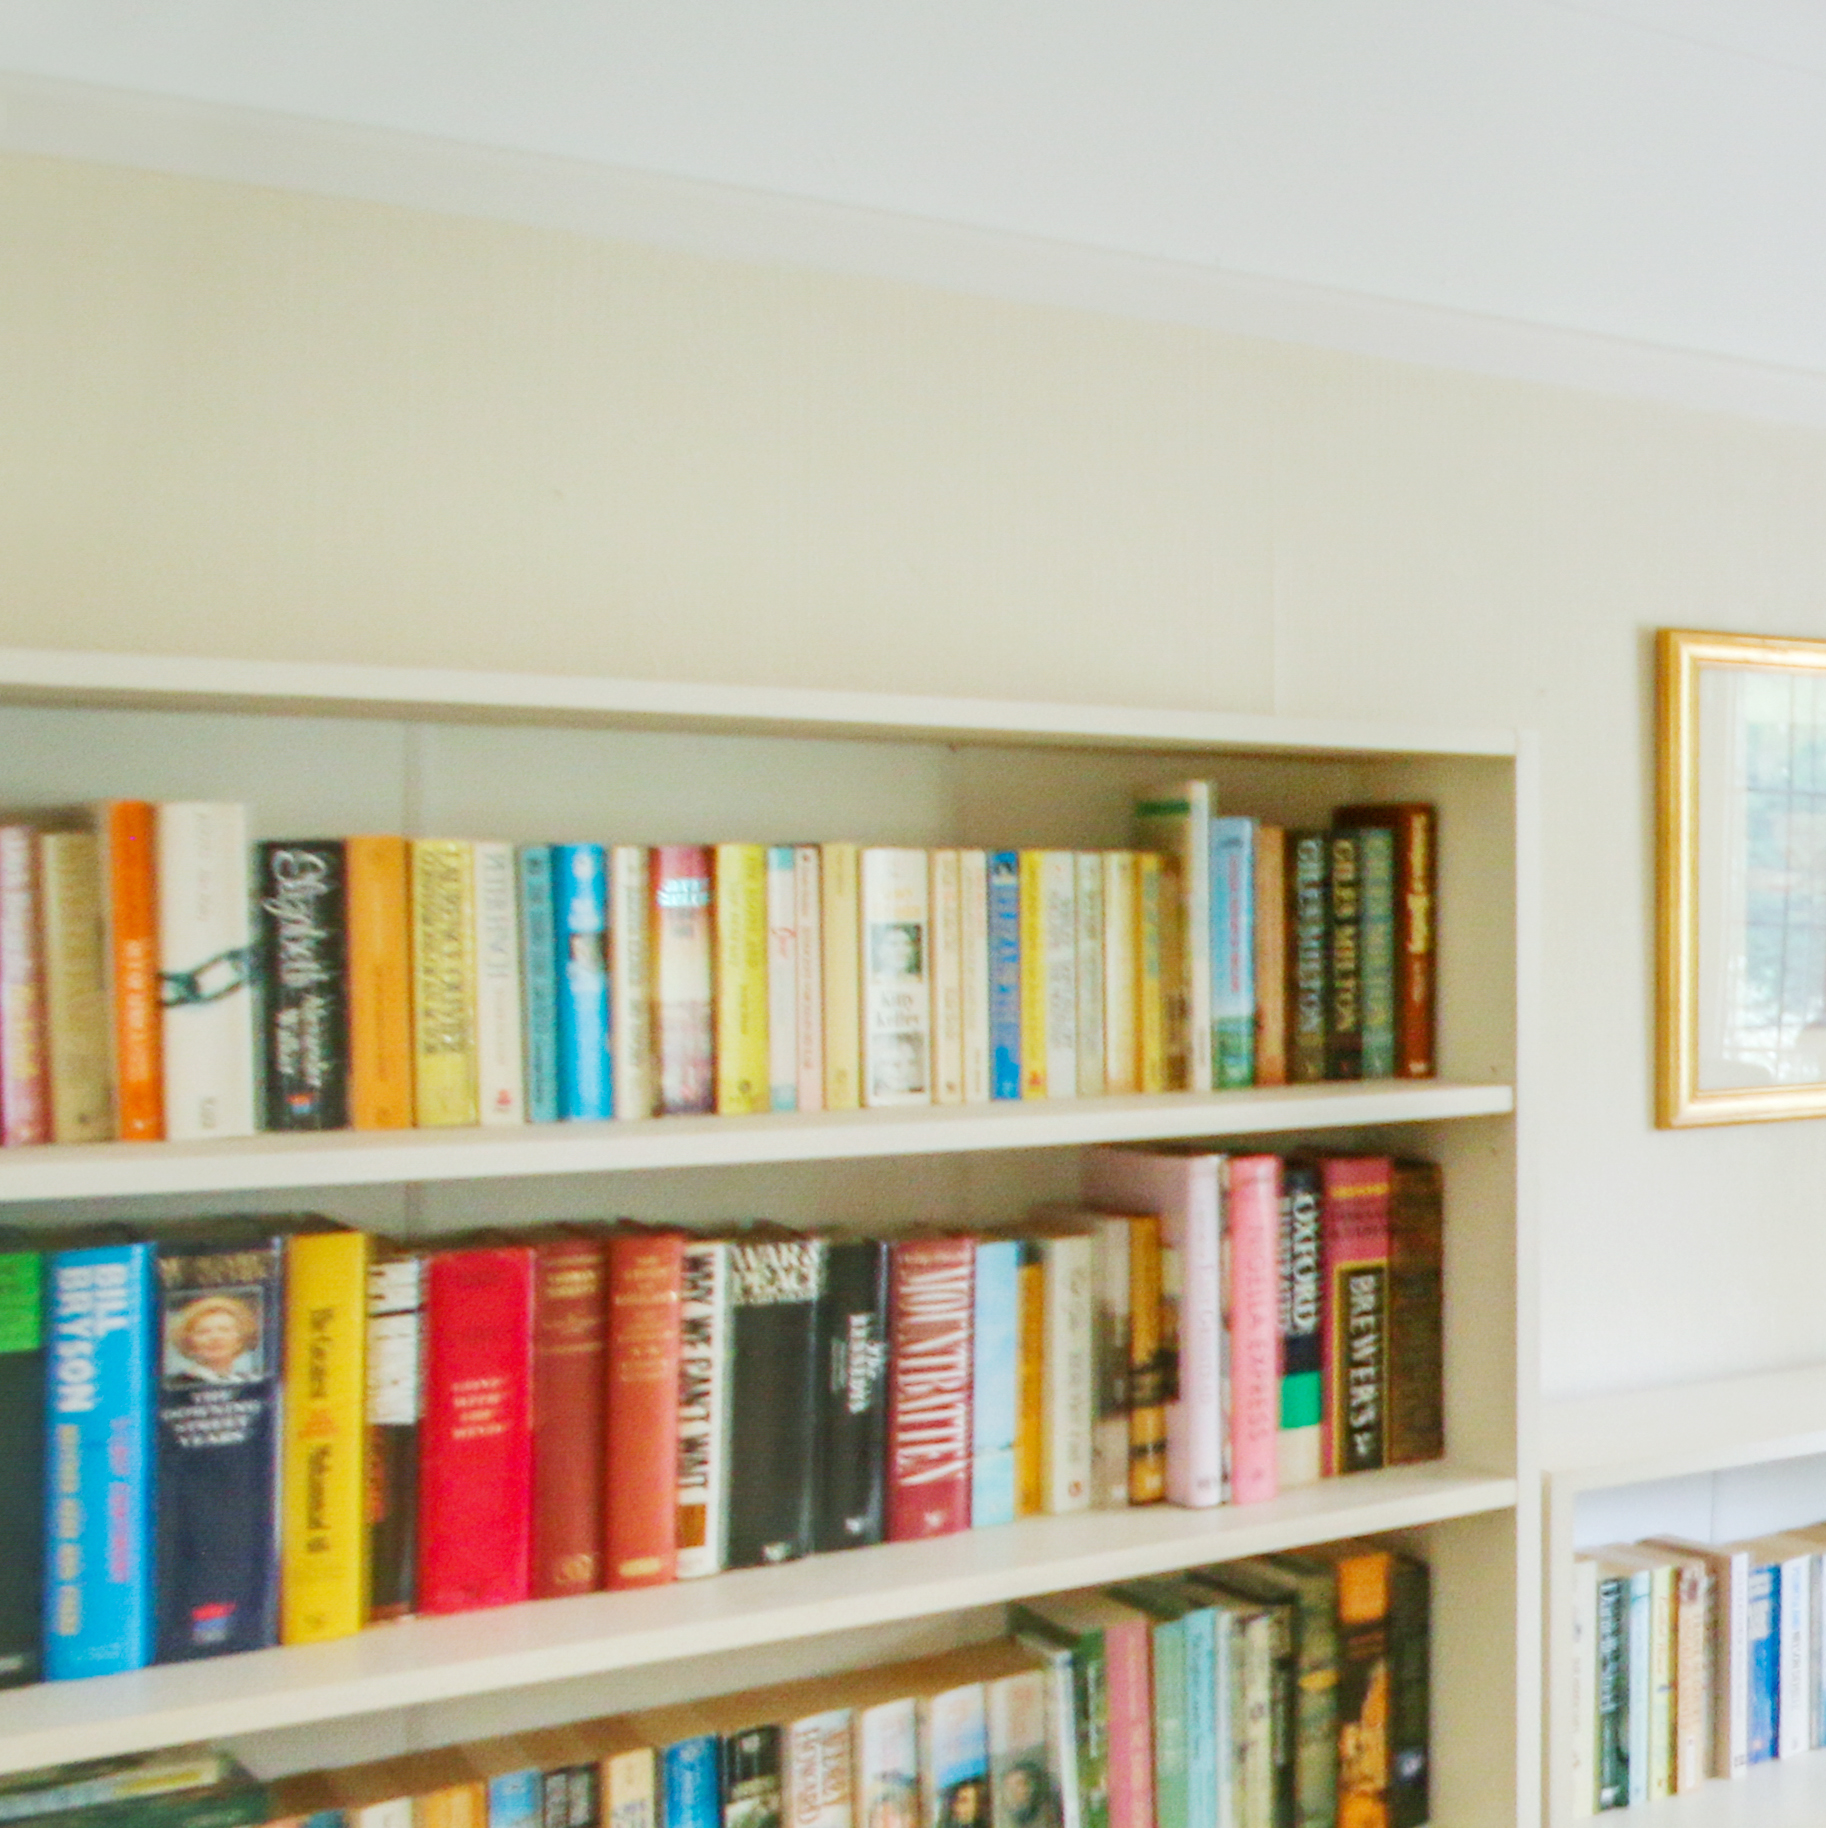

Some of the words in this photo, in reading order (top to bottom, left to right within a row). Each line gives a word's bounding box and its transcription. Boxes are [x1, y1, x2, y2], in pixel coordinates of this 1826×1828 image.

[262, 851, 331, 990] Elizabeth
[1299, 839, 1324, 918] GILES
[1333, 839, 1356, 918] GILES
[1299, 924, 1324, 1033] MILTON
[1333, 924, 1356, 1032] MILTON
[97, 1264, 129, 1340] BILL
[681, 1252, 714, 1304] WHY
[1293, 1193, 1319, 1335] OXFORD
[57, 1265, 98, 1414] BRYSON
[681, 1315, 712, 1350] WE
[1349, 1275, 1377, 1429] BREWER'S
[679, 1357, 711, 1424] CAN'T
[1246, 1339, 1268, 1441] EXPRESS
[677, 1432, 710, 1490] WAIT
